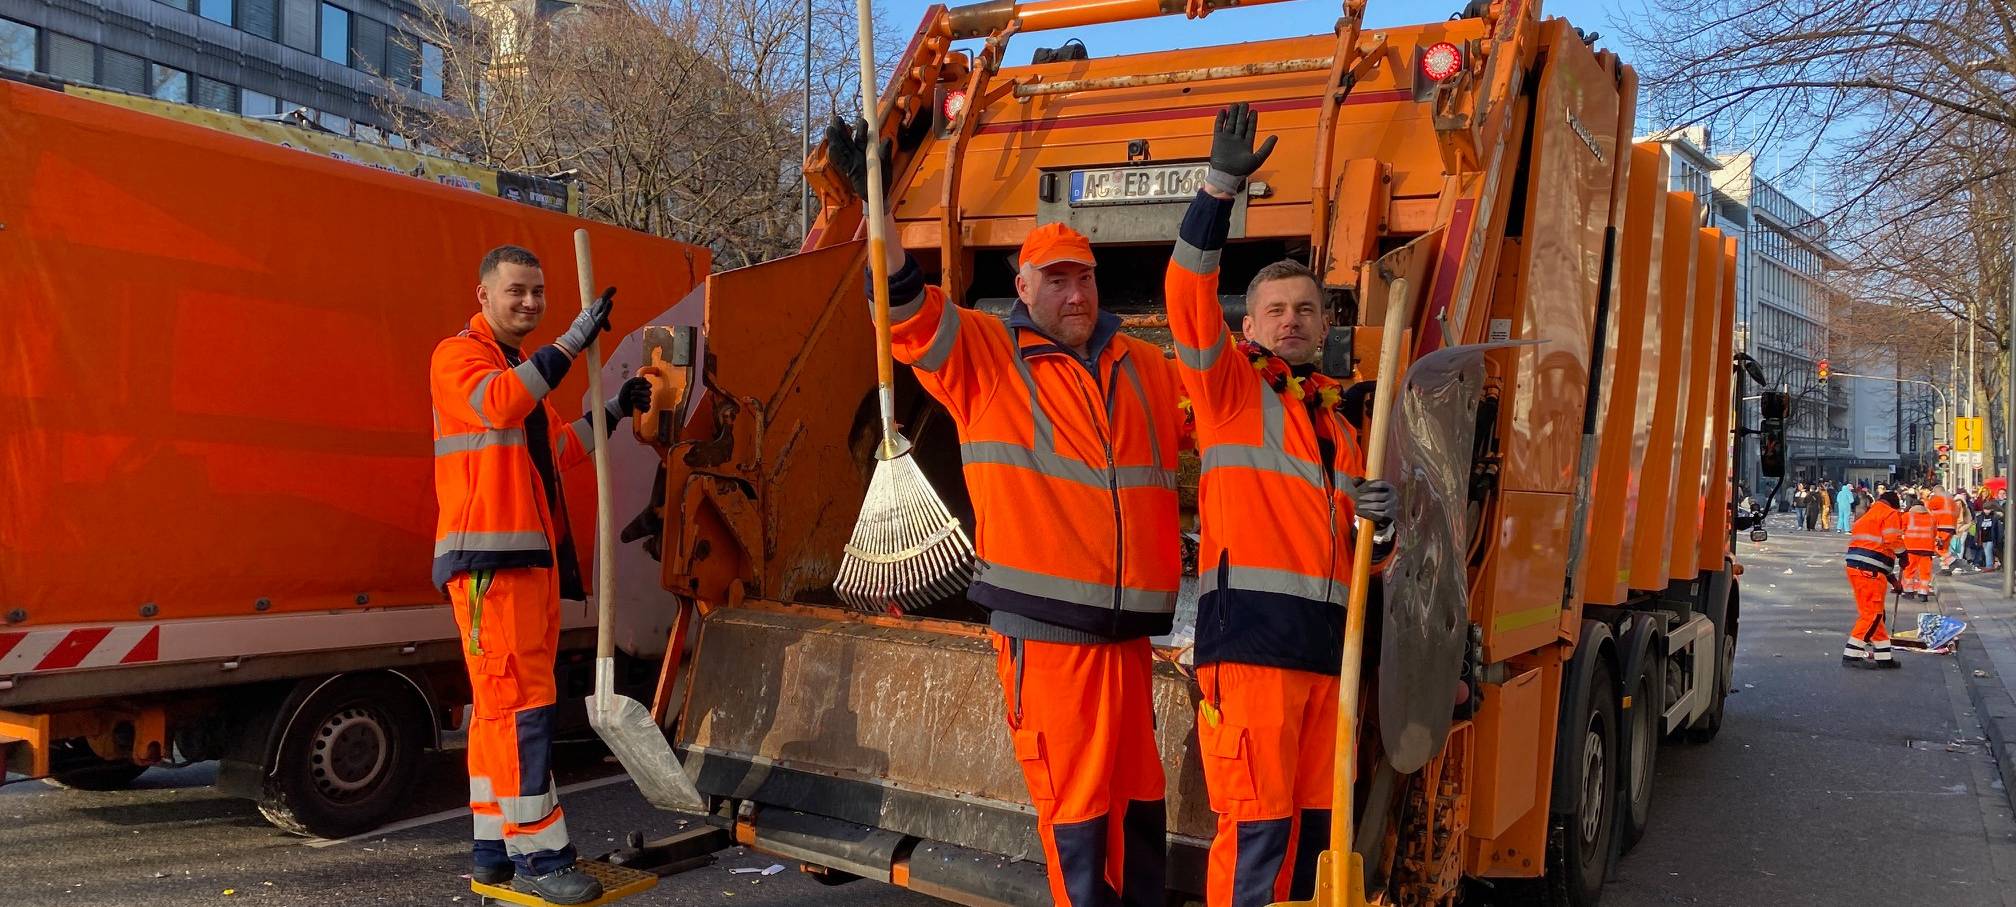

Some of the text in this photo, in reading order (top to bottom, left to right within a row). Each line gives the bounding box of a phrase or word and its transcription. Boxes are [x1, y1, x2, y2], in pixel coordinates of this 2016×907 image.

[1084, 168, 1206, 198] AC EB 1068
